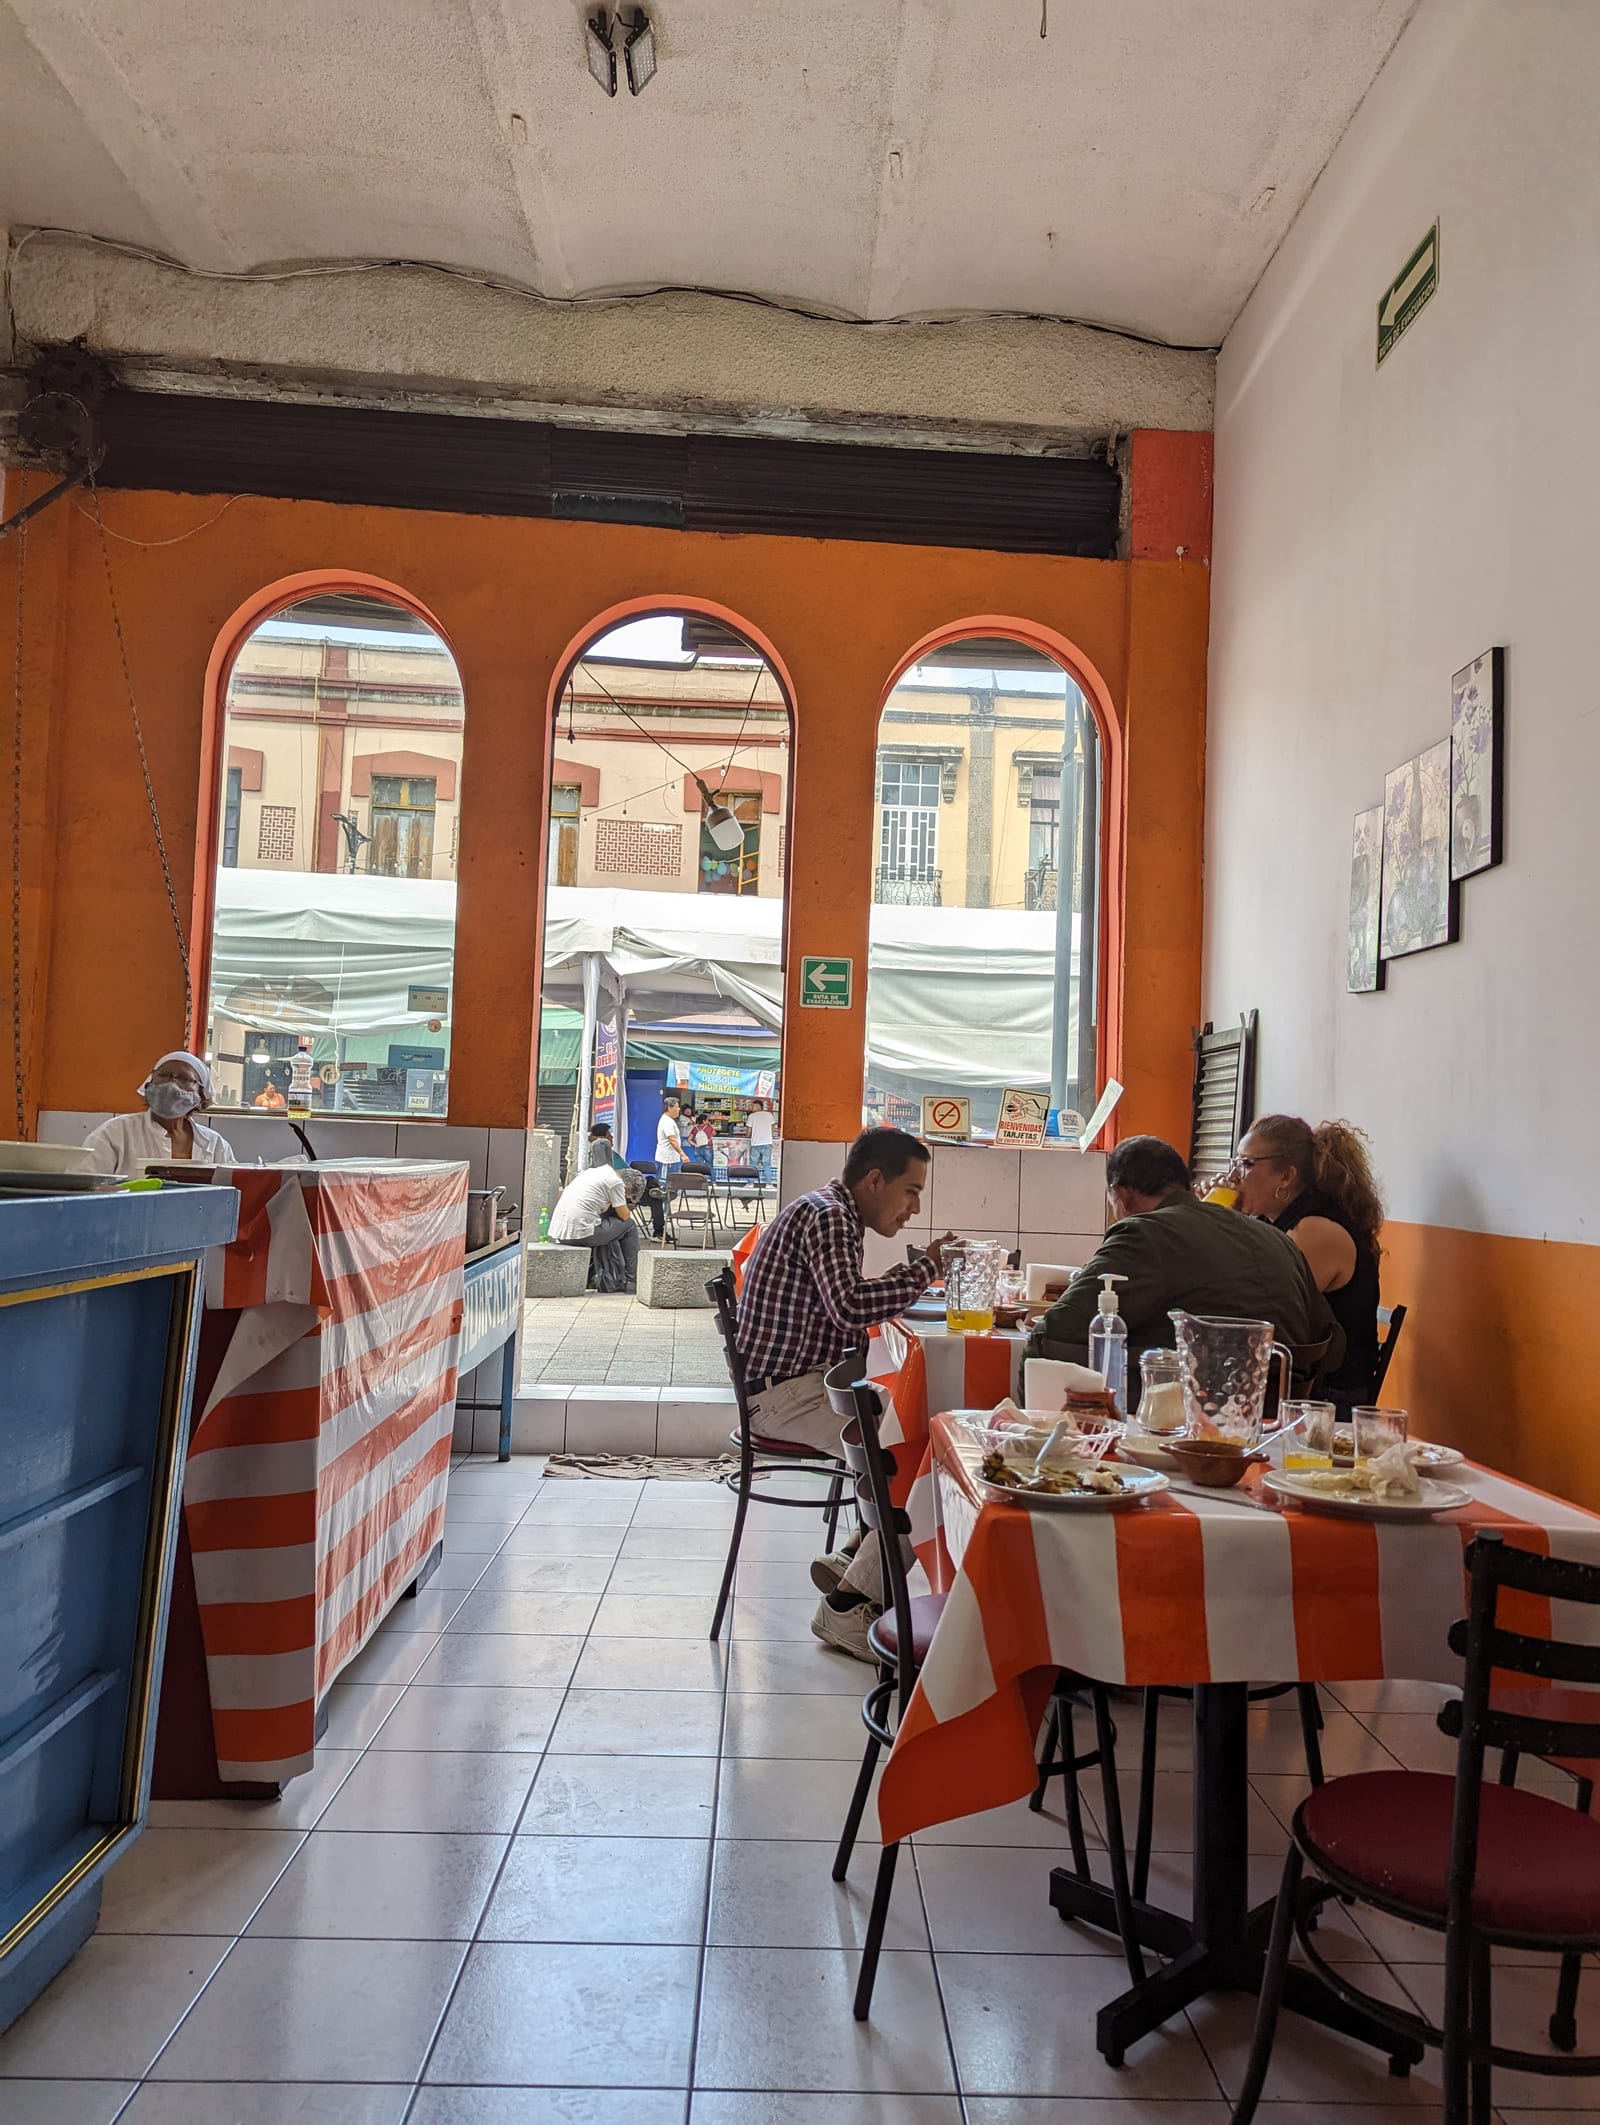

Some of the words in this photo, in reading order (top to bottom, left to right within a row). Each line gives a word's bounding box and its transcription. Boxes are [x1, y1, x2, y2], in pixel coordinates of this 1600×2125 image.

[1000, 1120, 1042, 1133] BIENVENIDAS
[1003, 1130, 1038, 1140] TARJETAS
[458, 1254, 521, 1355] HUARACHE
